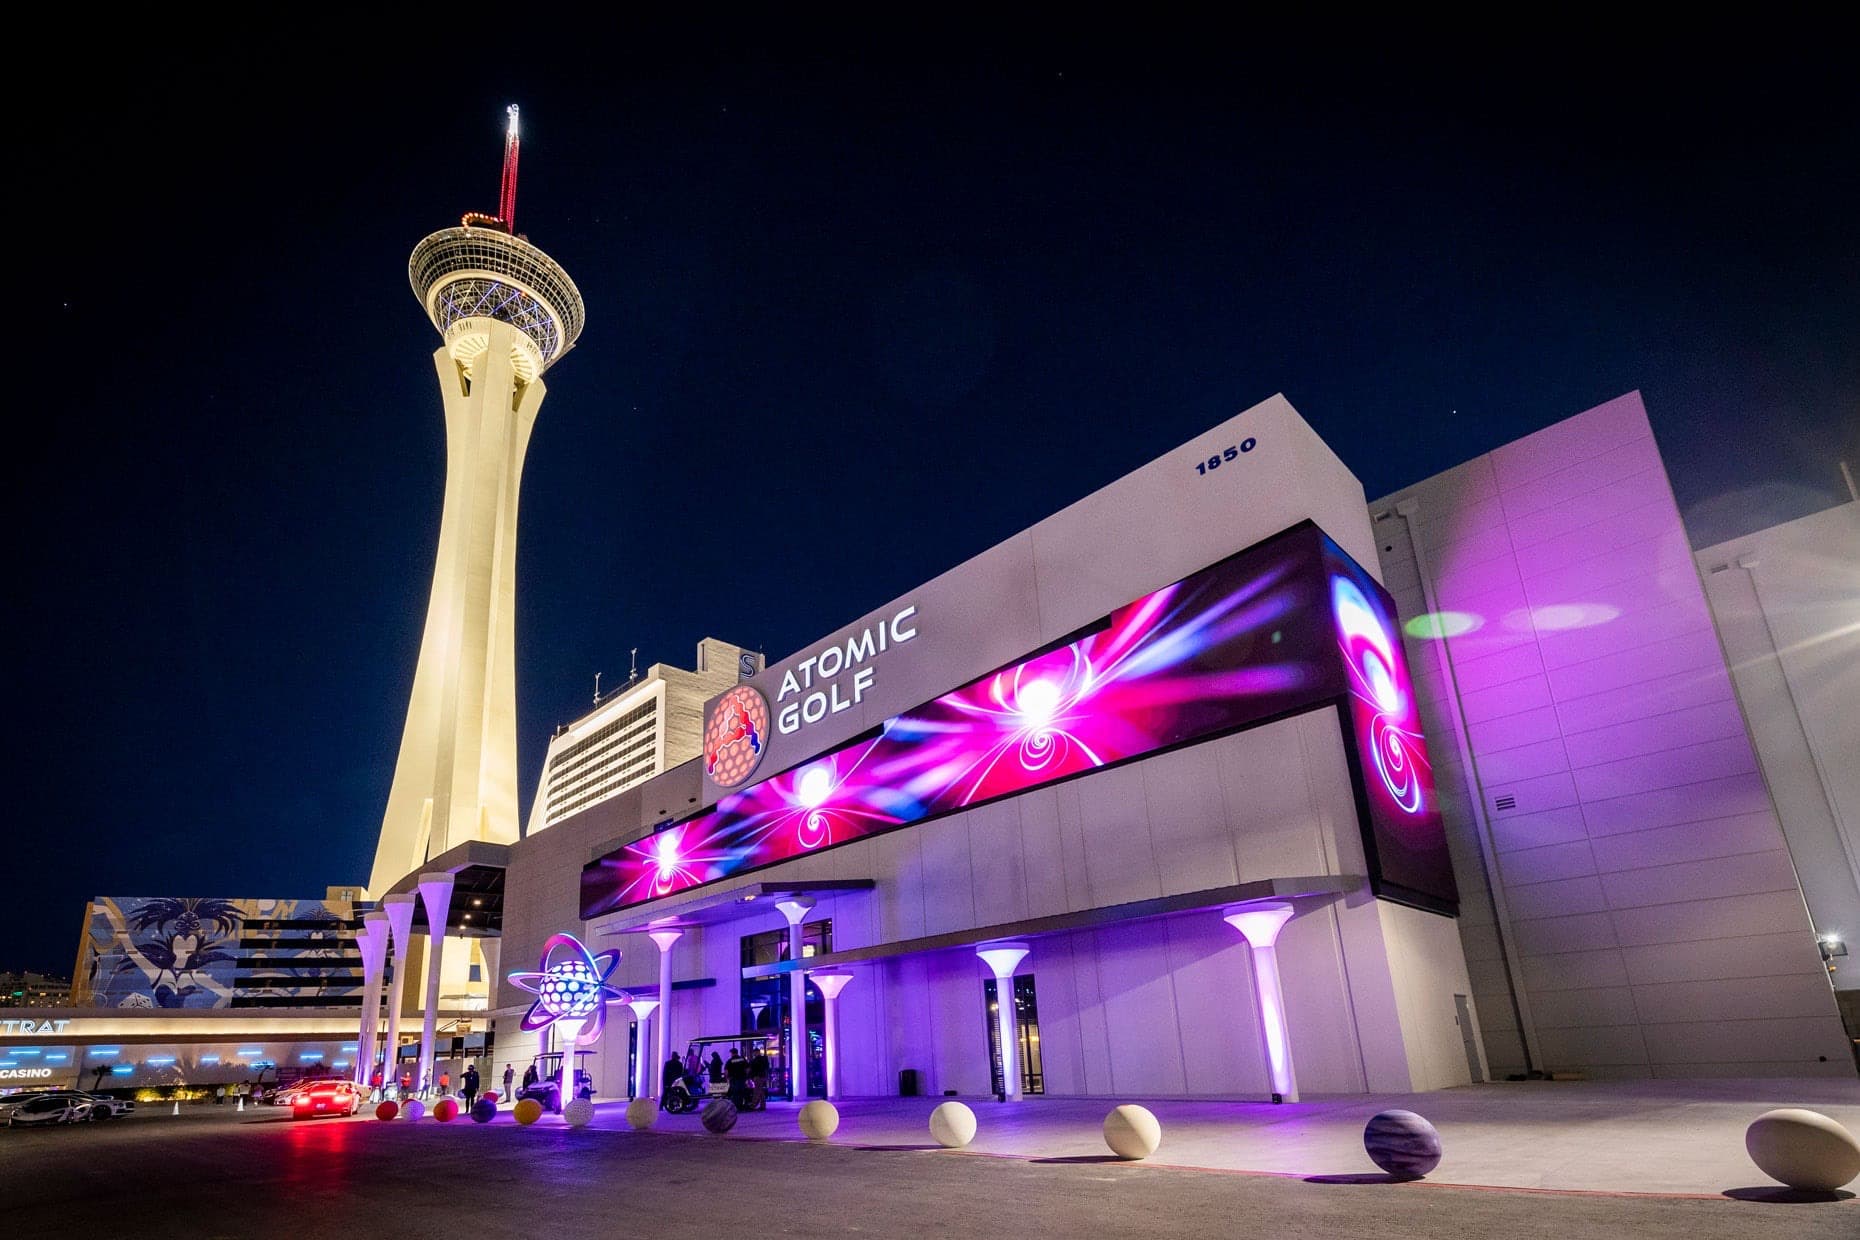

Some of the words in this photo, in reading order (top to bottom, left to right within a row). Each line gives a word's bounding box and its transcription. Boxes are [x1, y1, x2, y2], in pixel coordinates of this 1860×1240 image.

[1195, 437, 1256, 476] 1850
[777, 605, 916, 702] ATOMIC
[778, 666, 874, 735] GOLF
[0, 1020, 70, 1035] TRAT
[0, 1068, 52, 1079] CASINO
